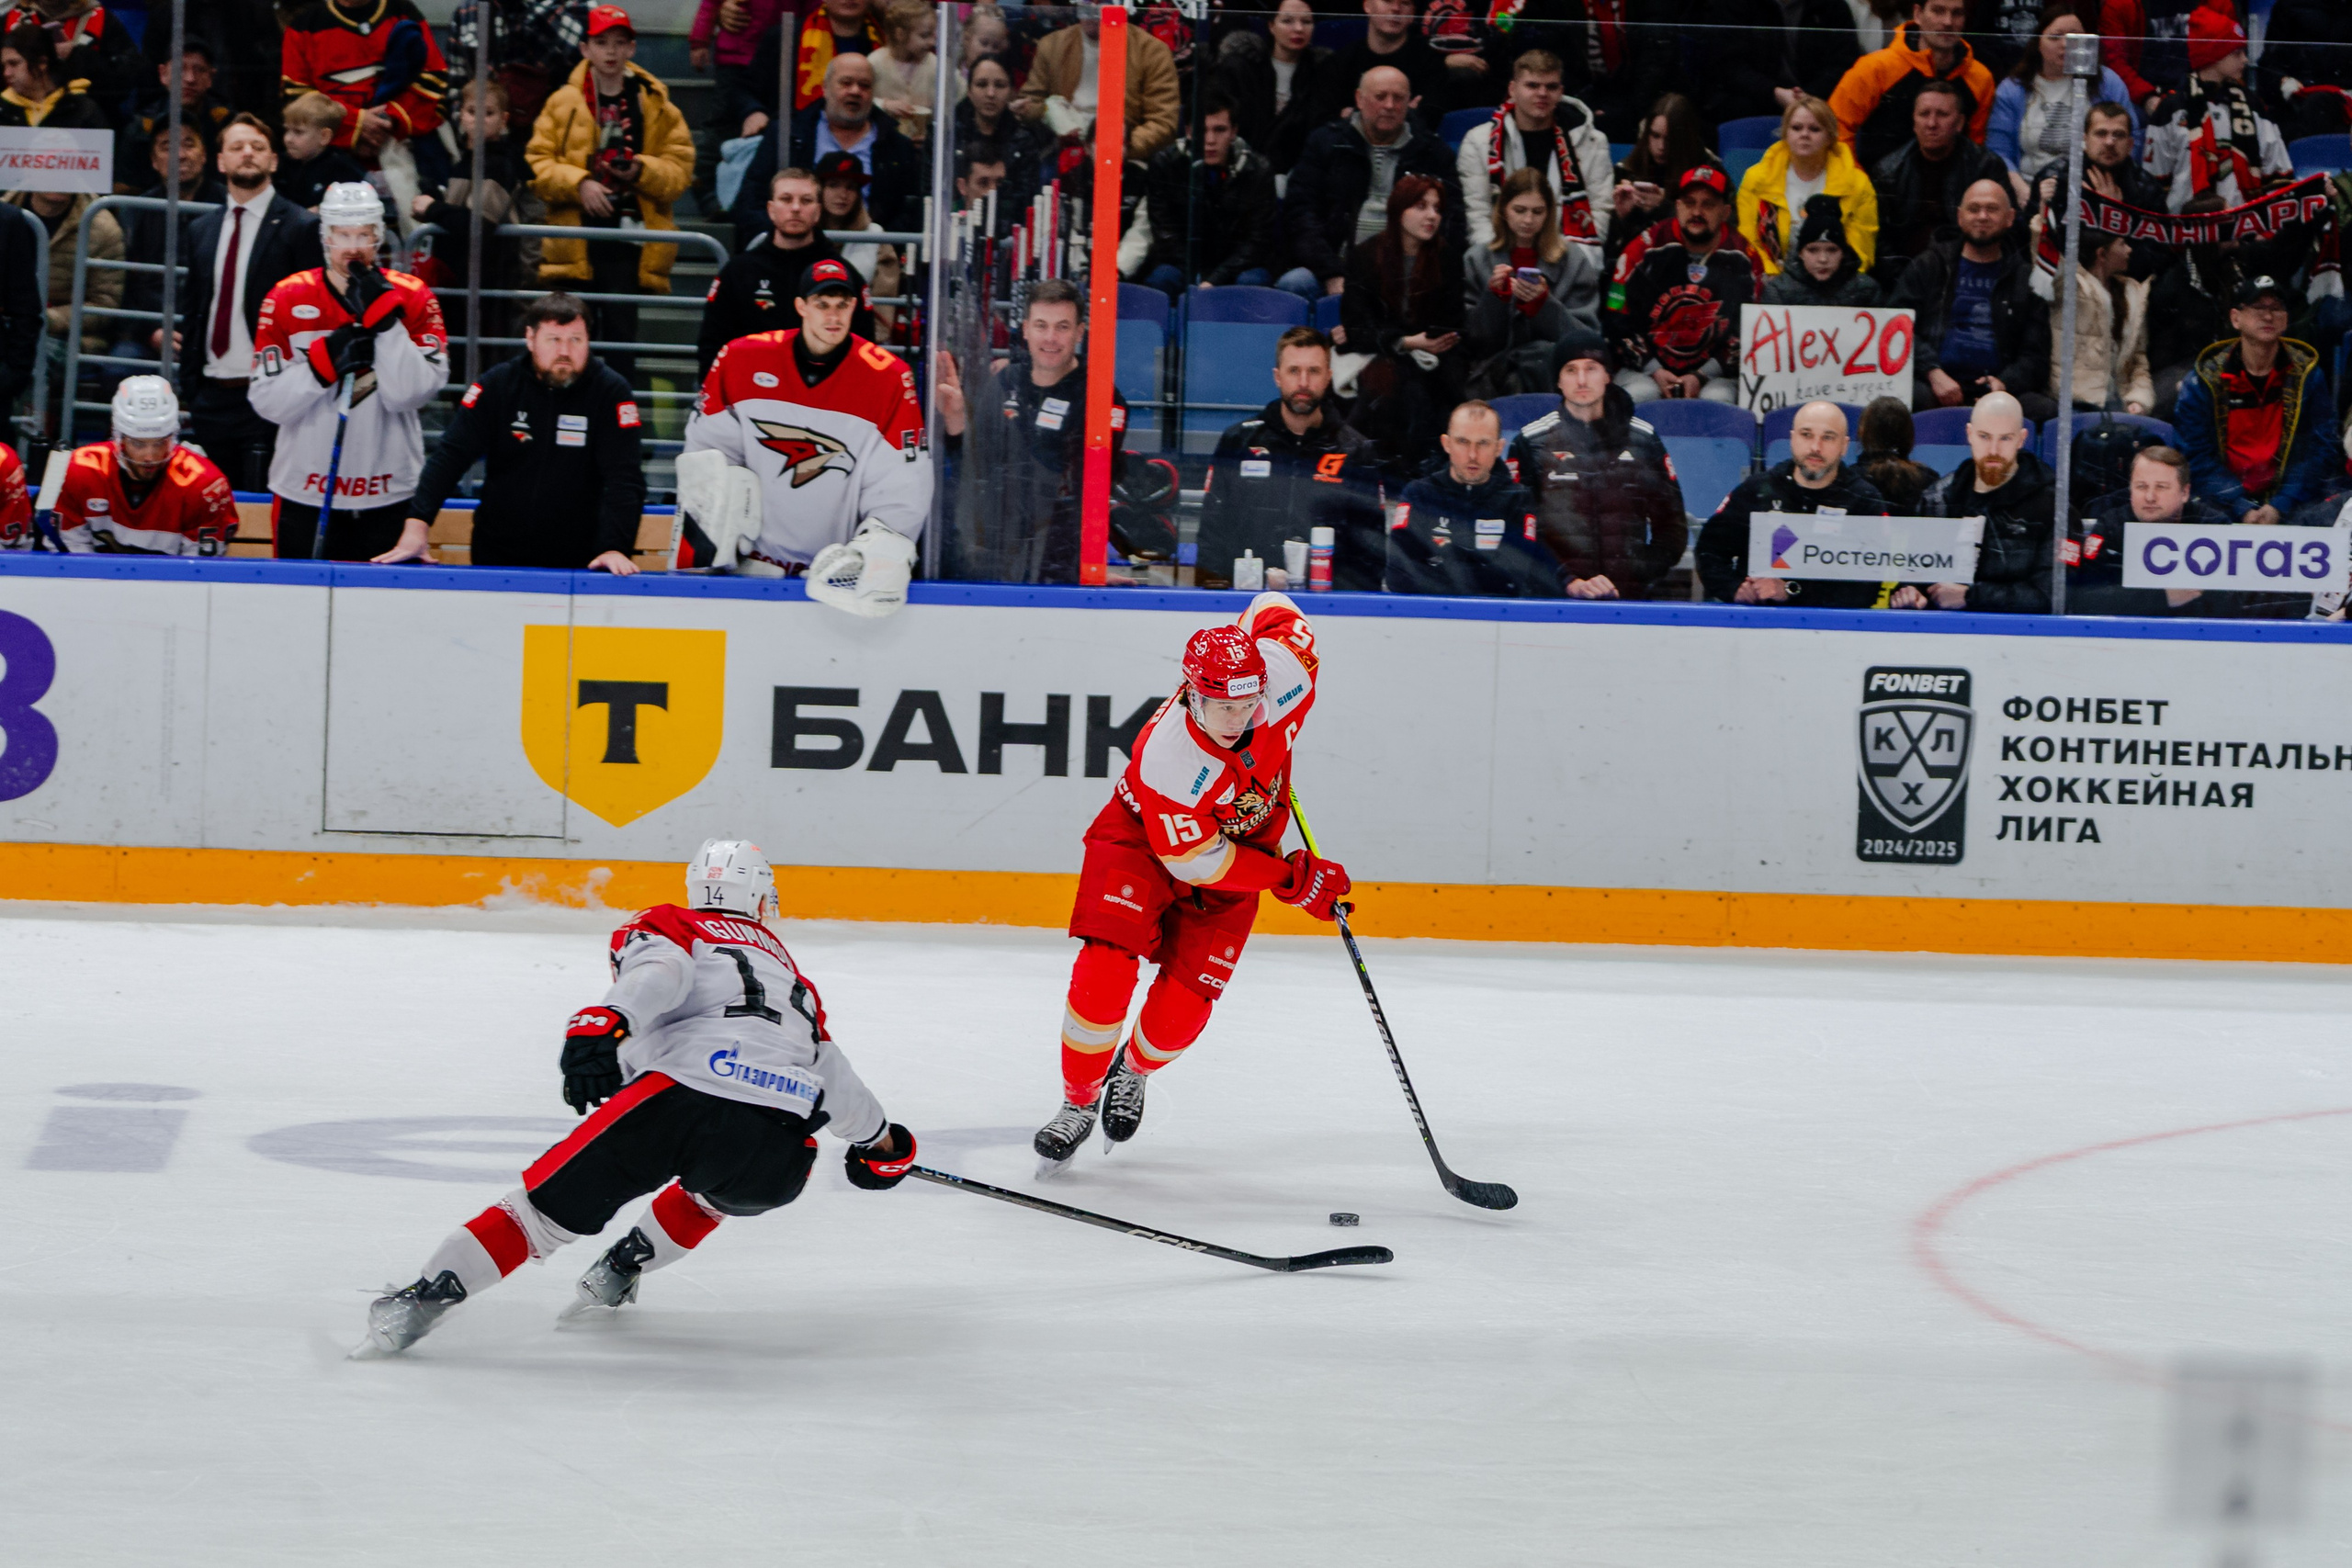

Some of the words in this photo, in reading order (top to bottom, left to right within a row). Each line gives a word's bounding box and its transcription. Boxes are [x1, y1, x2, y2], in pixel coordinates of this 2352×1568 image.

[1740, 372, 1788, 414] You
[1803, 545, 1954, 569] Ростелеком
[1226, 645, 1247, 660] 15
[1276, 683, 1304, 707] SIBUR
[1869, 672, 1966, 694] FONBET
[2002, 694, 2169, 727] ФОНБЕТ
[771, 685, 1169, 779] БАНК
[2001, 735, 2352, 772] КОНТИНЕНТАЛЬН
[1191, 765, 1211, 796] SIBUR
[1996, 773, 2255, 808] ХОККЕЙНАЯ
[1158, 813, 1204, 848] 15
[1996, 815, 2101, 844] ЛИГА
[1862, 838, 1958, 857] 2024/2025
[704, 886, 725, 906] 14
[921, 1167, 963, 1184] CCM
